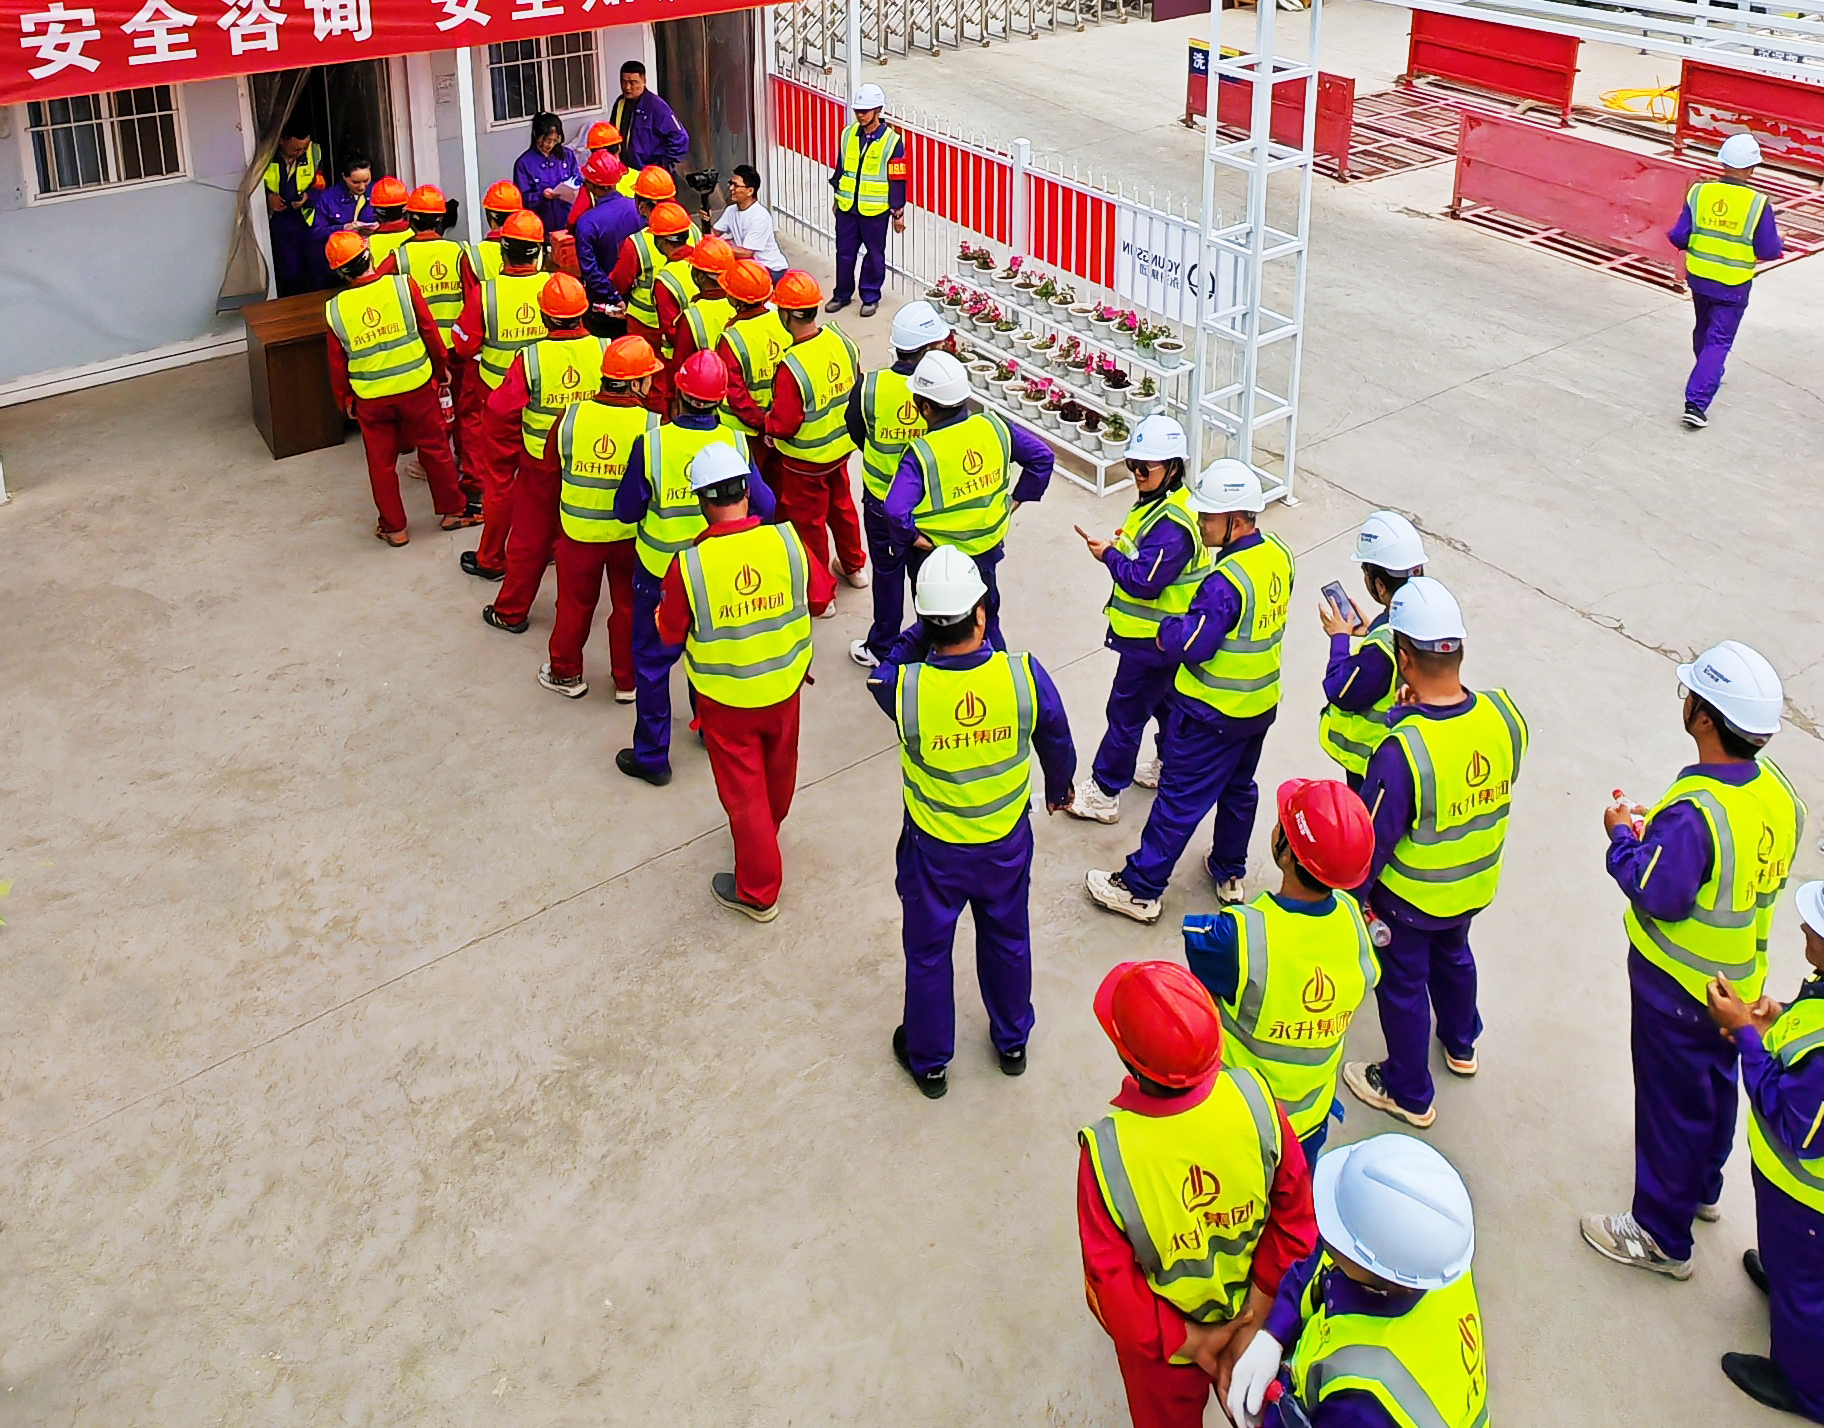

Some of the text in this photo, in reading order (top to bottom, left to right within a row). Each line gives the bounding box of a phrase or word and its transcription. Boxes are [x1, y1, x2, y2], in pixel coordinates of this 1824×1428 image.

[718, 591, 785, 620] 永升集团
[931, 725, 1012, 752] 永升集团
[1447, 779, 1510, 818] 永升集团
[1268, 1009, 1352, 1040] 永升集团
